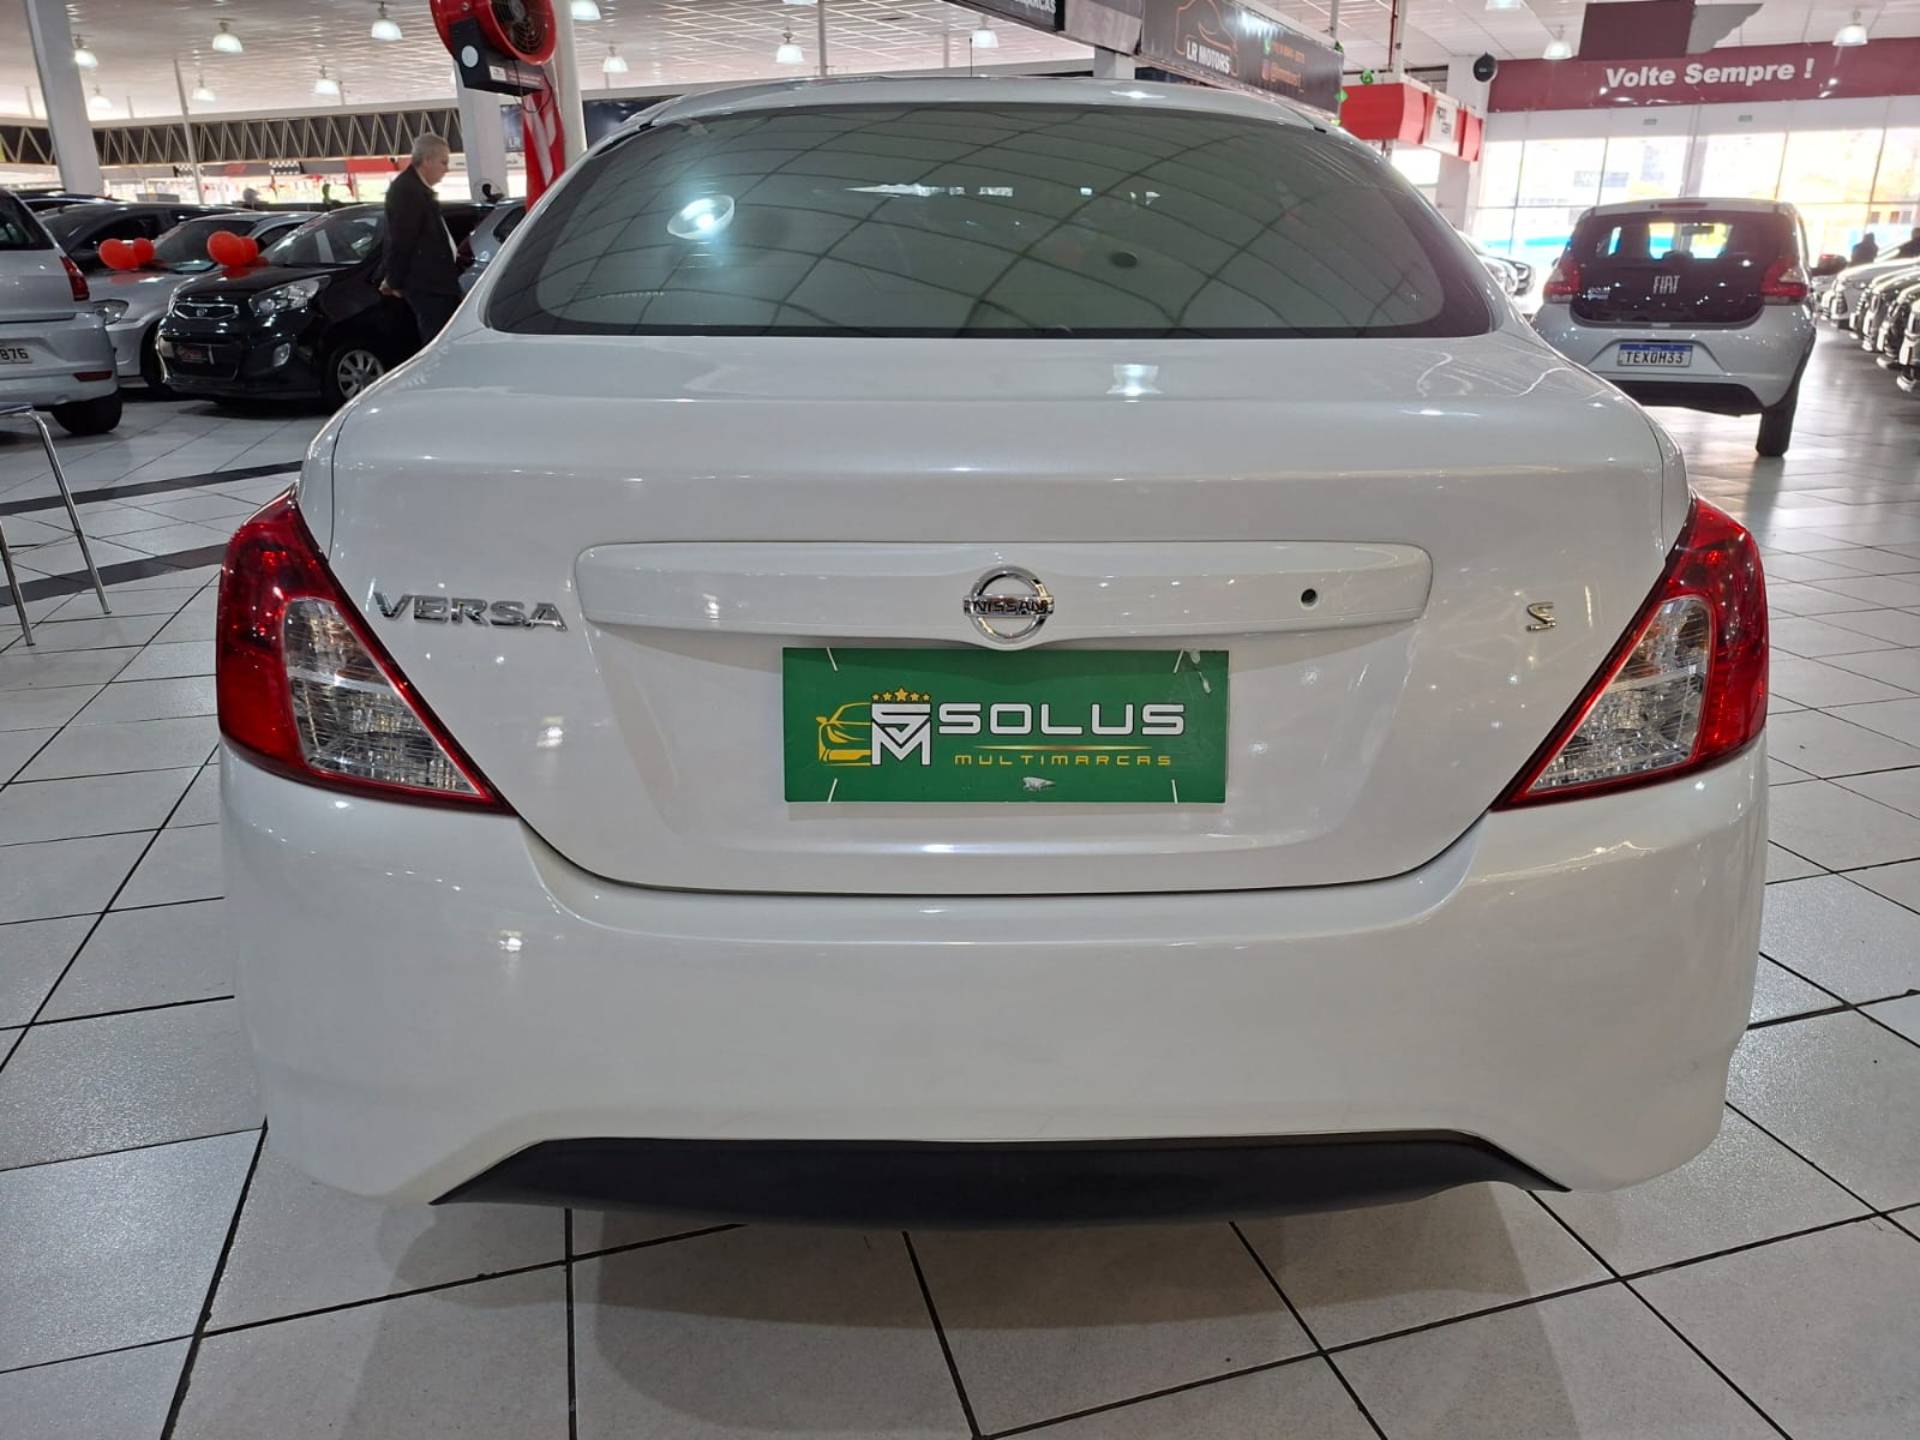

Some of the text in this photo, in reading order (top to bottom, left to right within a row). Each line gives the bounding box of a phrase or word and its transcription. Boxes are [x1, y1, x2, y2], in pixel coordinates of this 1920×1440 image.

[1199, 45, 1231, 74] MOTORS
[1605, 58, 1815, 88] Volte Sempre !
[1652, 275, 1680, 294] FIAT
[372, 591, 569, 633] VERSA
[971, 599, 1049, 616] NISSAN
[1525, 600, 1557, 632] S
[938, 702, 1185, 736] SOLUS
[953, 753, 1173, 767] MULTIMARCAS
